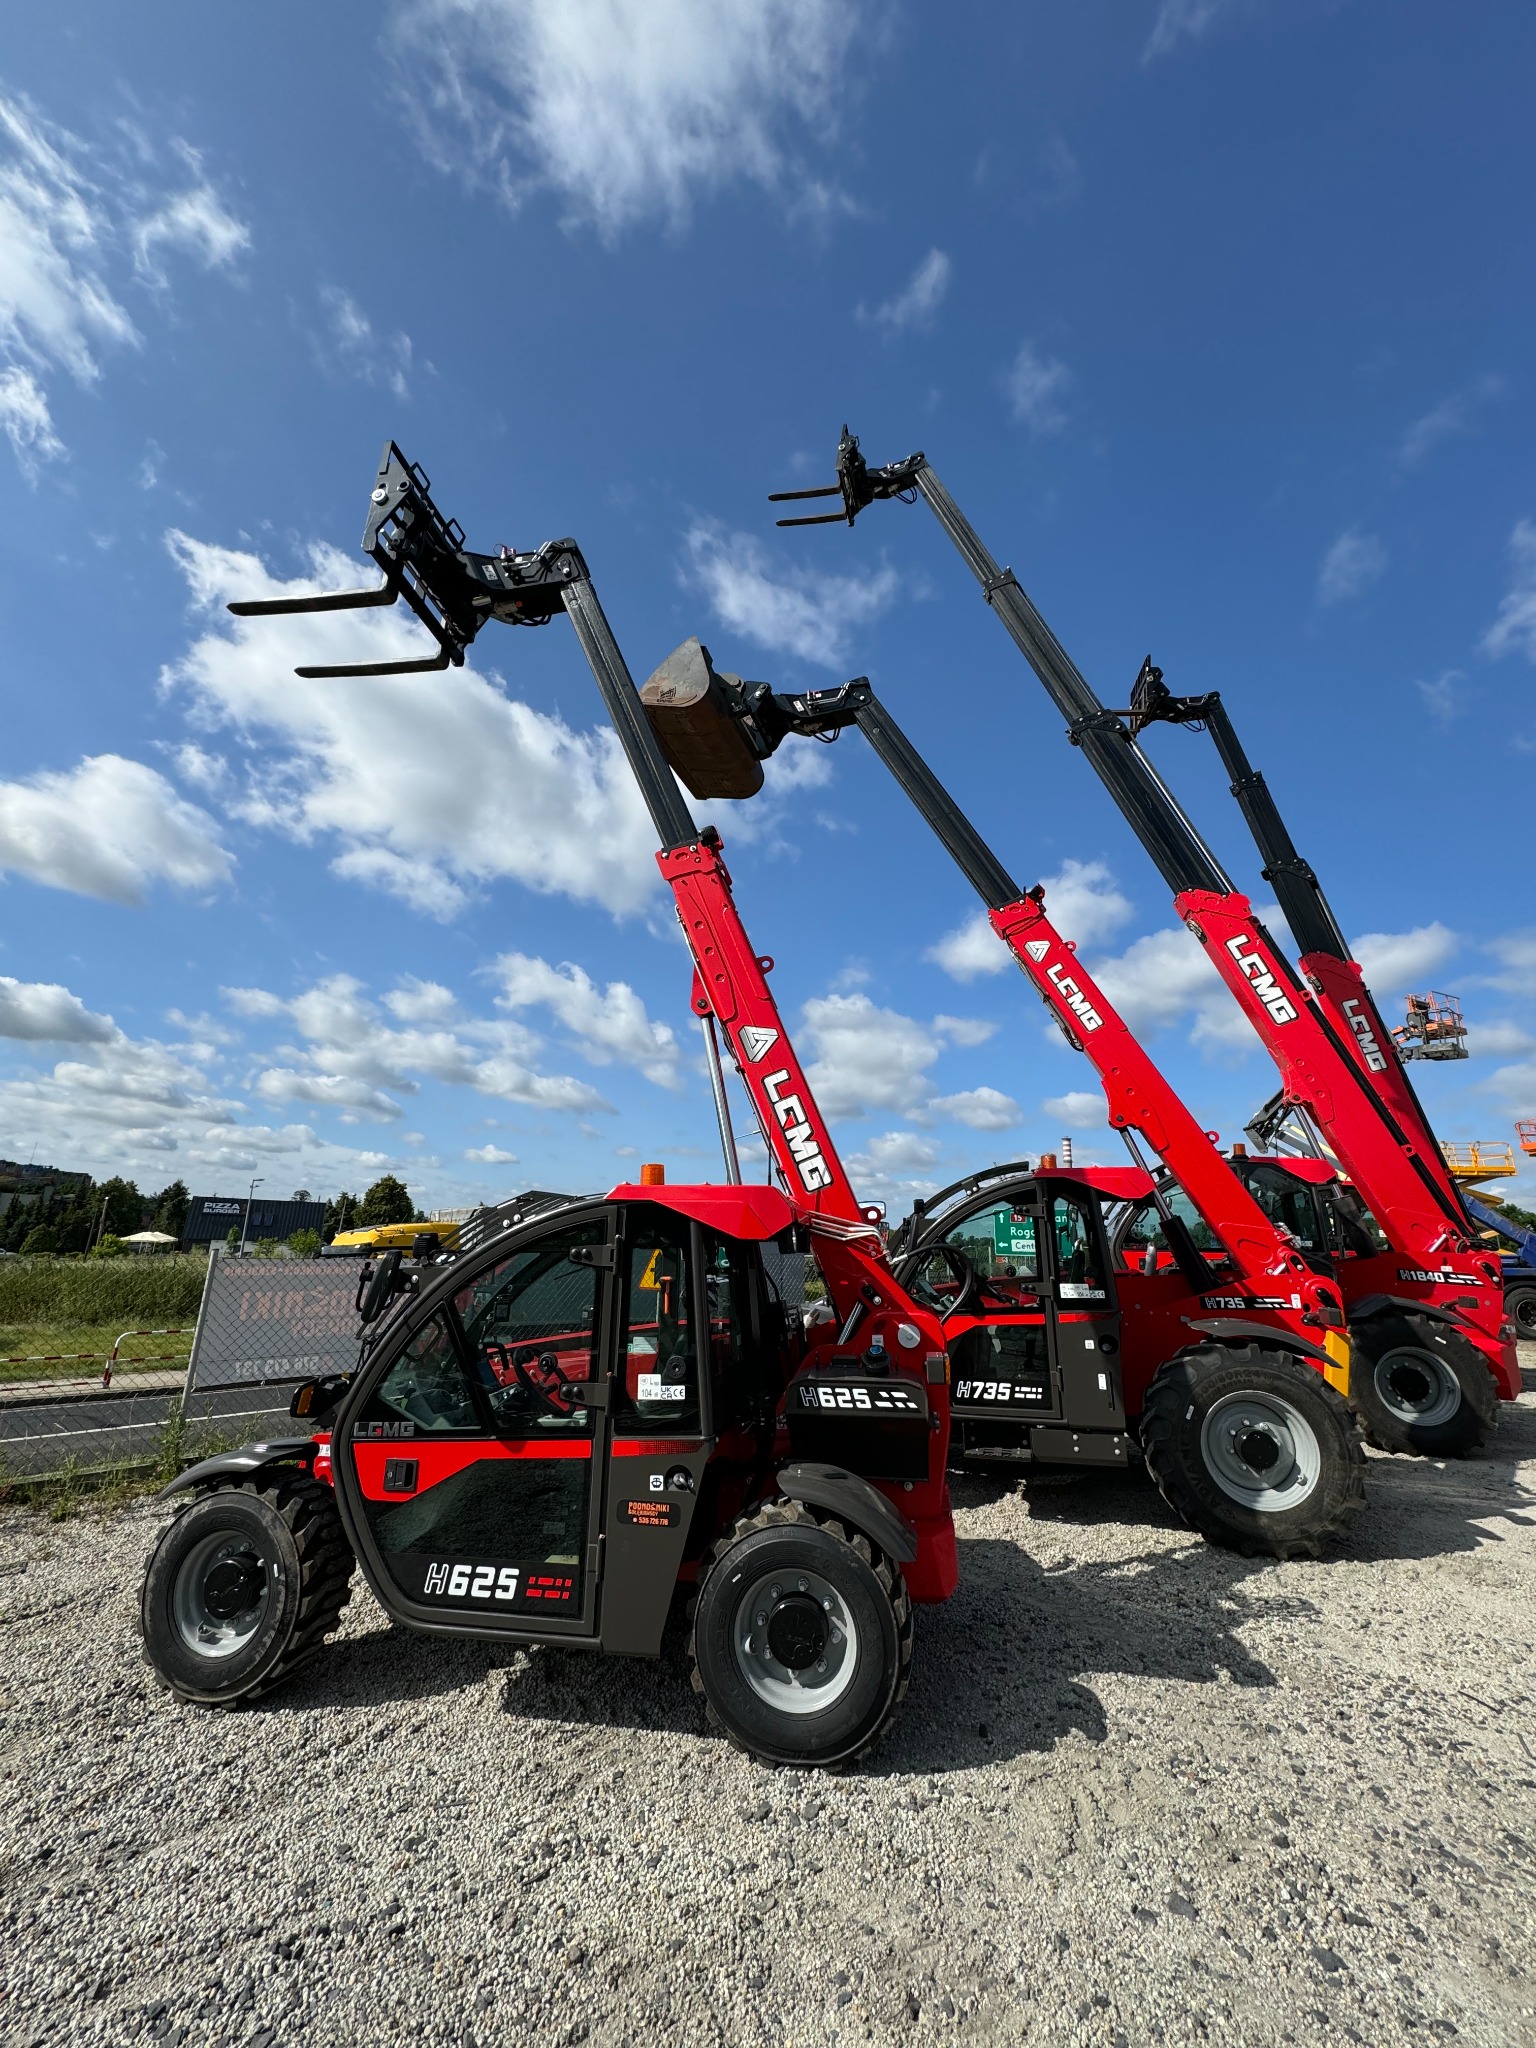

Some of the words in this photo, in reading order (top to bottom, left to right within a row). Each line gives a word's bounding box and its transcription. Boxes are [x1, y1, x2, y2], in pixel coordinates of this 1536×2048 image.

[204, 1201, 240, 1209] PIZZA
[1015, 1241, 1035, 1250] Cent
[1400, 1270, 1445, 1282] H1840
[1205, 1297, 1246, 1309] H735
[641, 1388, 652, 1398] 104
[957, 1380, 1011, 1400] H735
[800, 1386, 872, 1409] H625
[424, 1562, 520, 1600] H625
